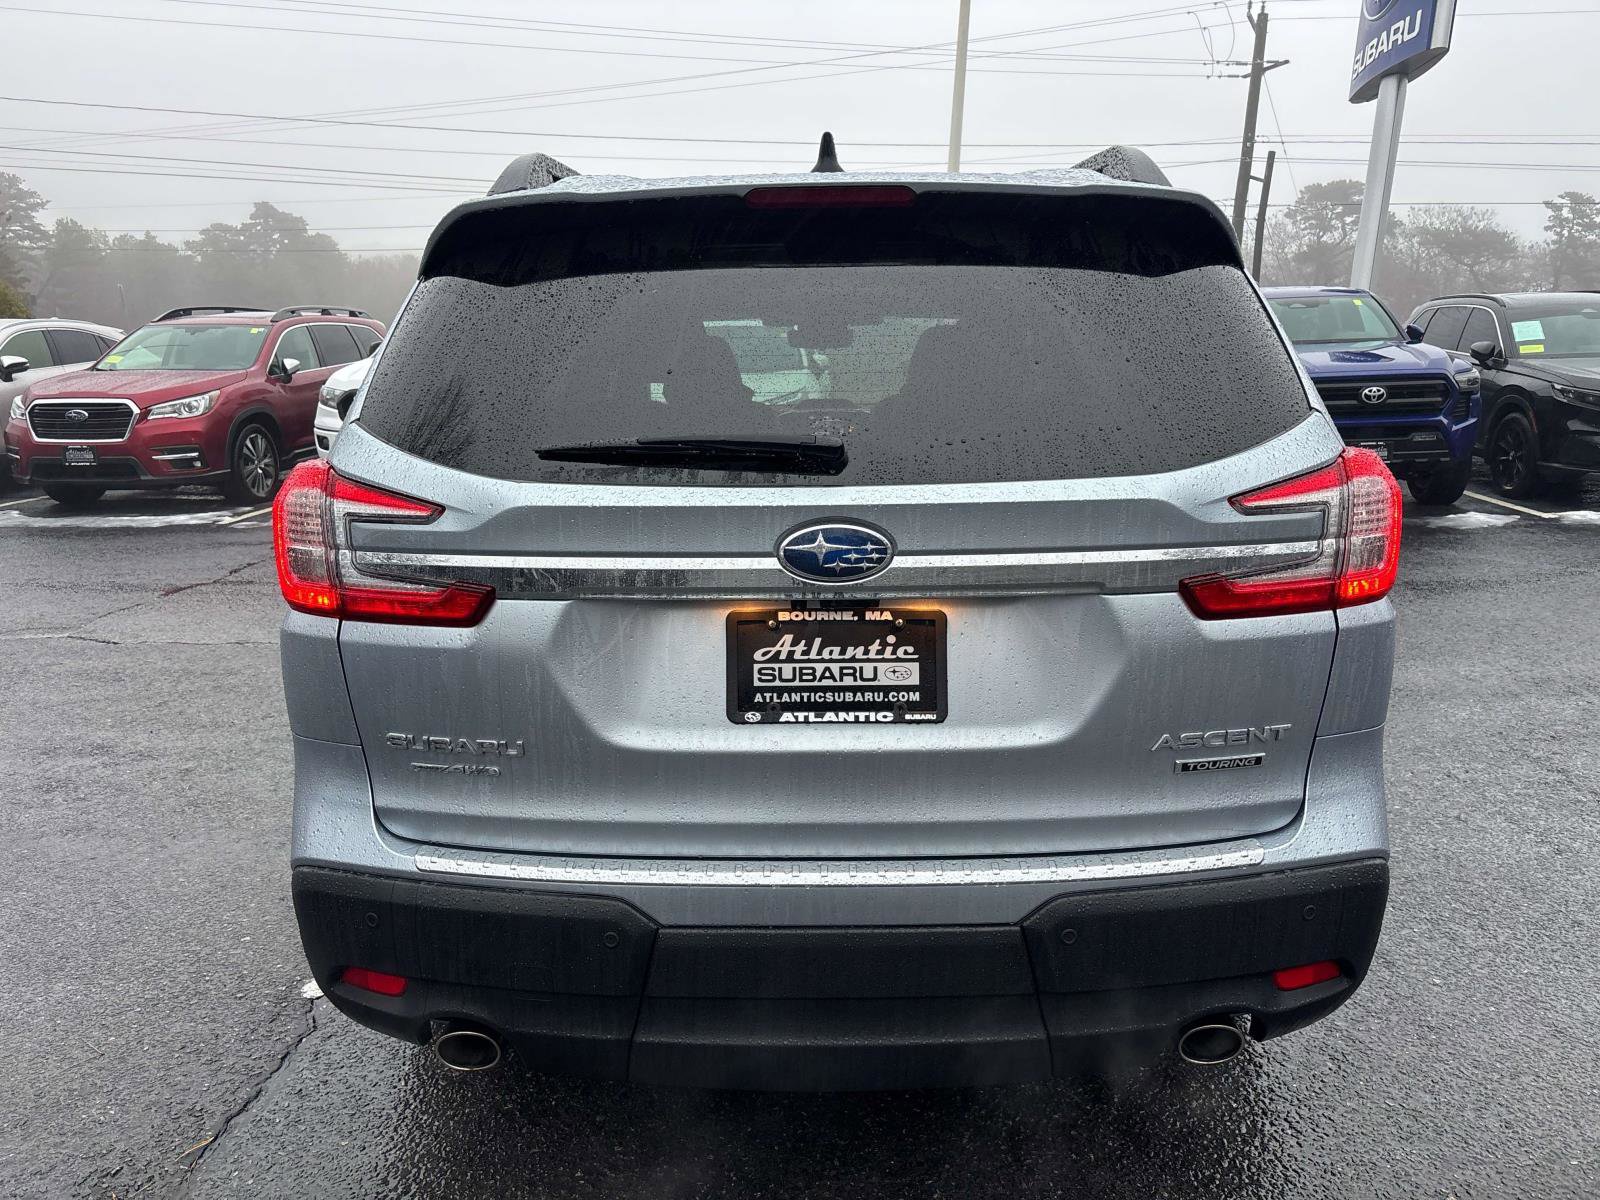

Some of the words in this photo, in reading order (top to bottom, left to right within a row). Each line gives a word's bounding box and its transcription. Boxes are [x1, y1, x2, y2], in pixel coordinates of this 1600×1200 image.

[1352, 9, 1422, 80] SUBARU
[778, 611, 858, 621] BOURNE,
[865, 611, 893, 621] MA
[753, 634, 919, 662] Atlantic
[757, 666, 878, 683] SUBARU
[754, 692, 920, 703] ATLANTICSUBARU.COM
[779, 712, 894, 722] ATLANTIC
[385, 732, 525, 757] SUBARU
[1151, 723, 1292, 751] ASCENT
[1187, 757, 1257, 771] TOURING
